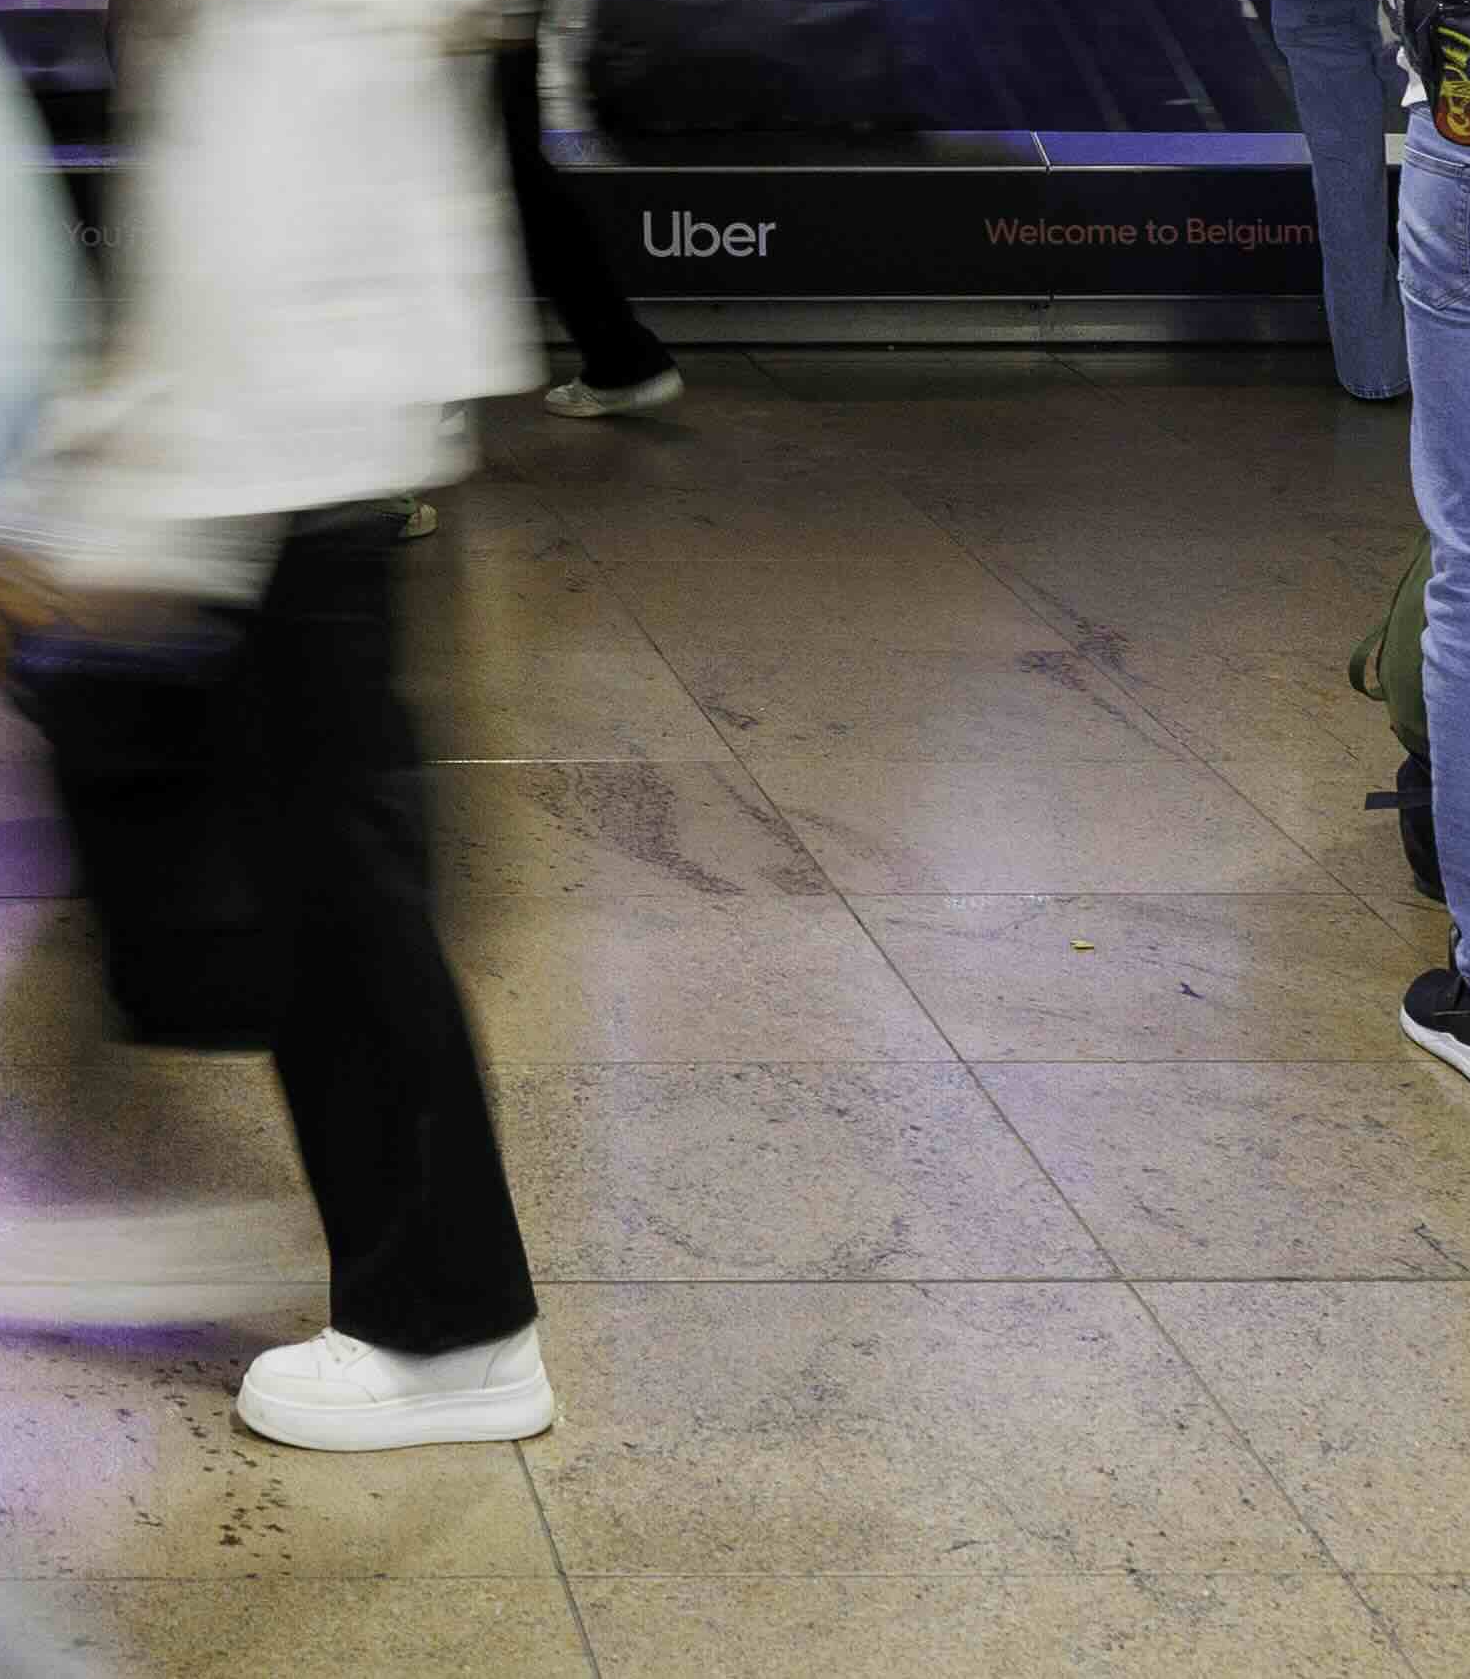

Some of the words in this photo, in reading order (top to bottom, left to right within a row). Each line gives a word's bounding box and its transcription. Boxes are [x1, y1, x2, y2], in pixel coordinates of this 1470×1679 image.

[642, 211, 777, 258] Uber
[984, 217, 1136, 247] Welcome
[1143, 219, 1179, 247] to
[1186, 217, 1314, 252] Belgium
